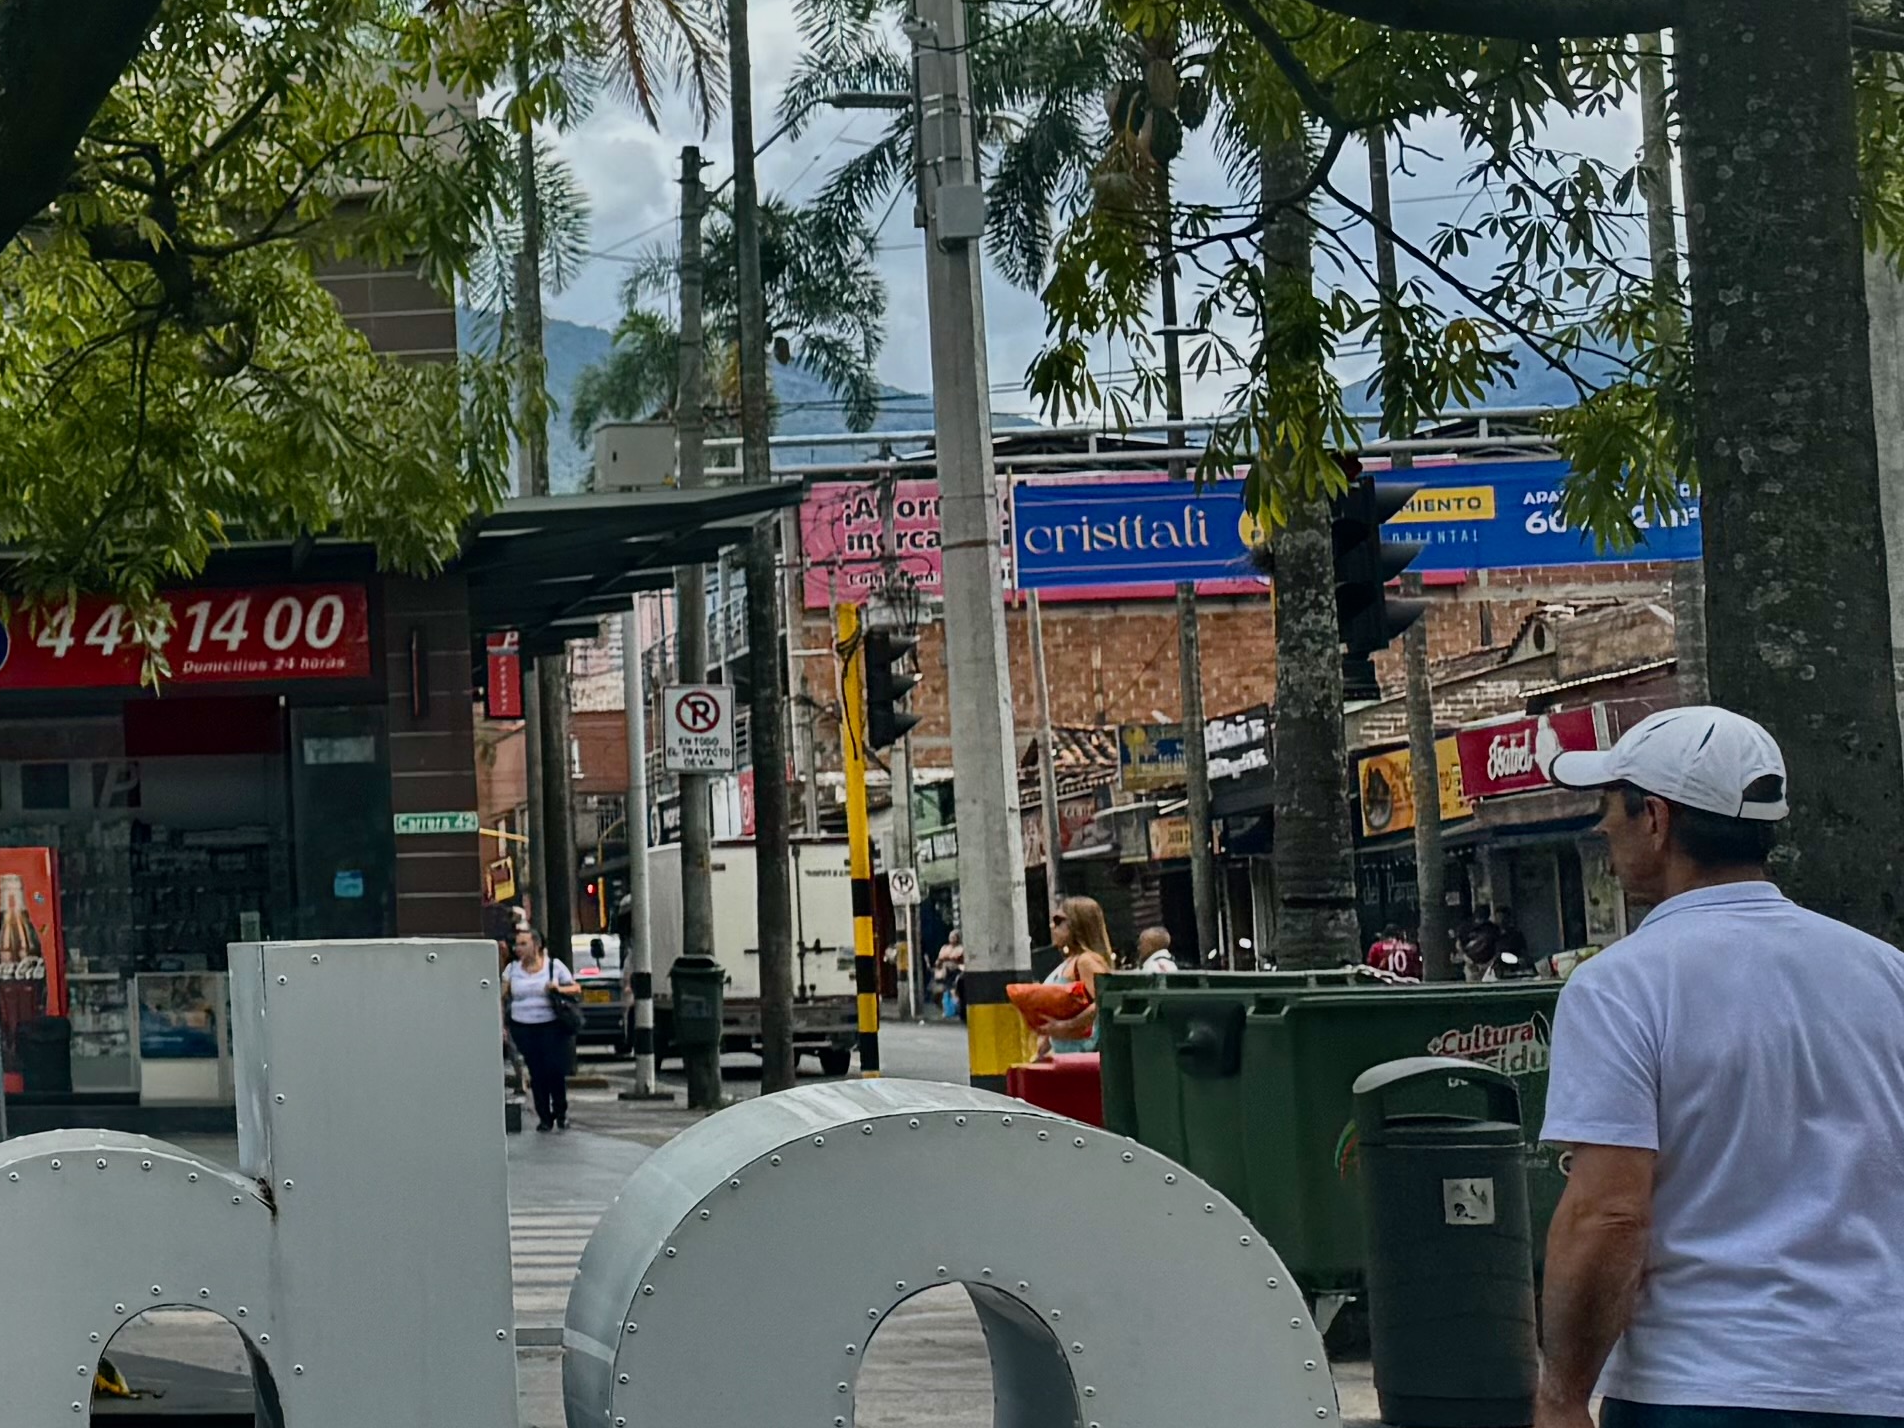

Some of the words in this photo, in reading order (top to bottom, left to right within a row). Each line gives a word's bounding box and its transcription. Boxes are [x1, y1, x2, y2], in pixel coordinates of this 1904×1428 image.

[1400, 496, 1482, 513] MIENTO
[1024, 505, 1209, 555] cristtali
[1388, 950, 1407, 972] 10
